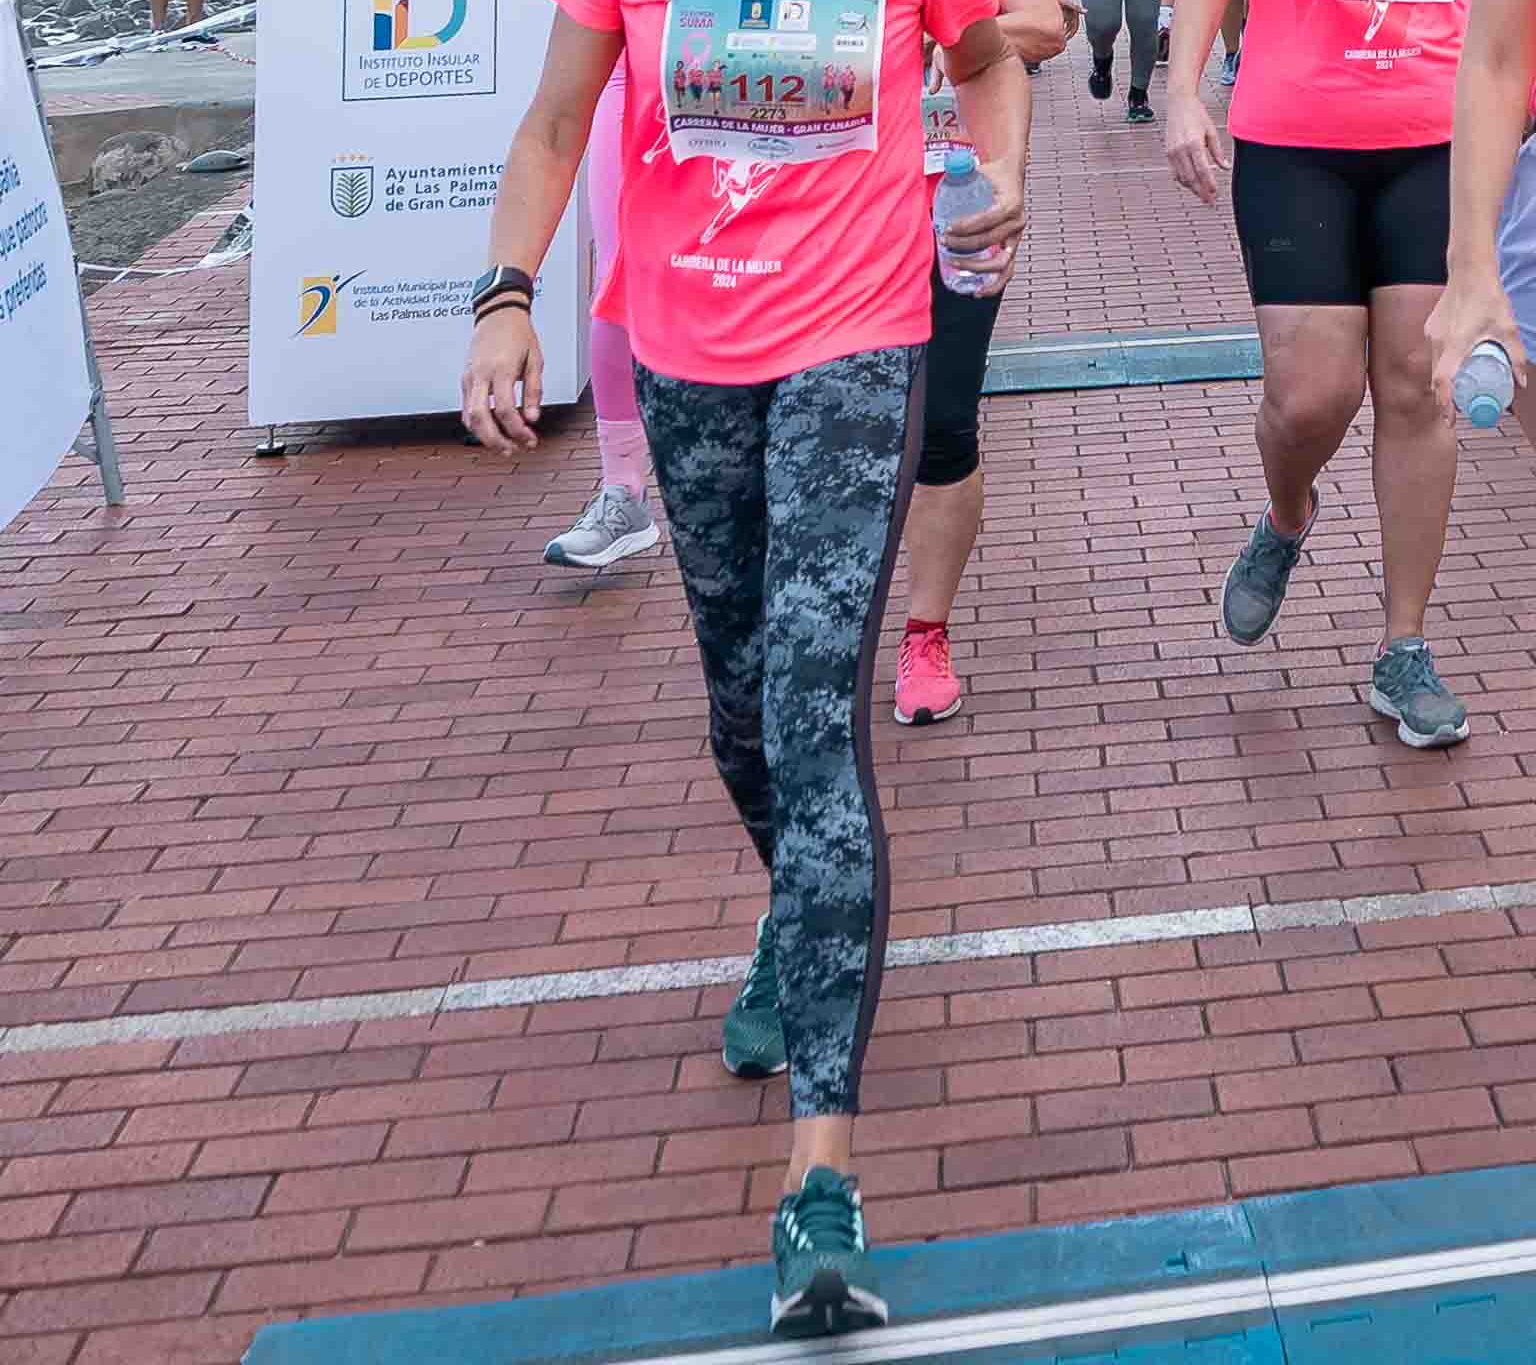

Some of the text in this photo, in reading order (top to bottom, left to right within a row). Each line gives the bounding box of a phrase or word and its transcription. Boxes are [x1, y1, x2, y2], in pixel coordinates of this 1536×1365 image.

[359, 52, 481, 71] INSTITUTO INSULAR
[364, 69, 474, 90] DE DEPORTES
[729, 73, 807, 103] 112
[750, 107, 786, 120] 2273
[674, 117, 720, 129] CARRERA
[721, 119, 736, 130] DE
[736, 120, 751, 132] LA
[792, 122, 822, 135] GRAN
[385, 180, 441, 197] de Las
[385, 195, 444, 212] de Gran
